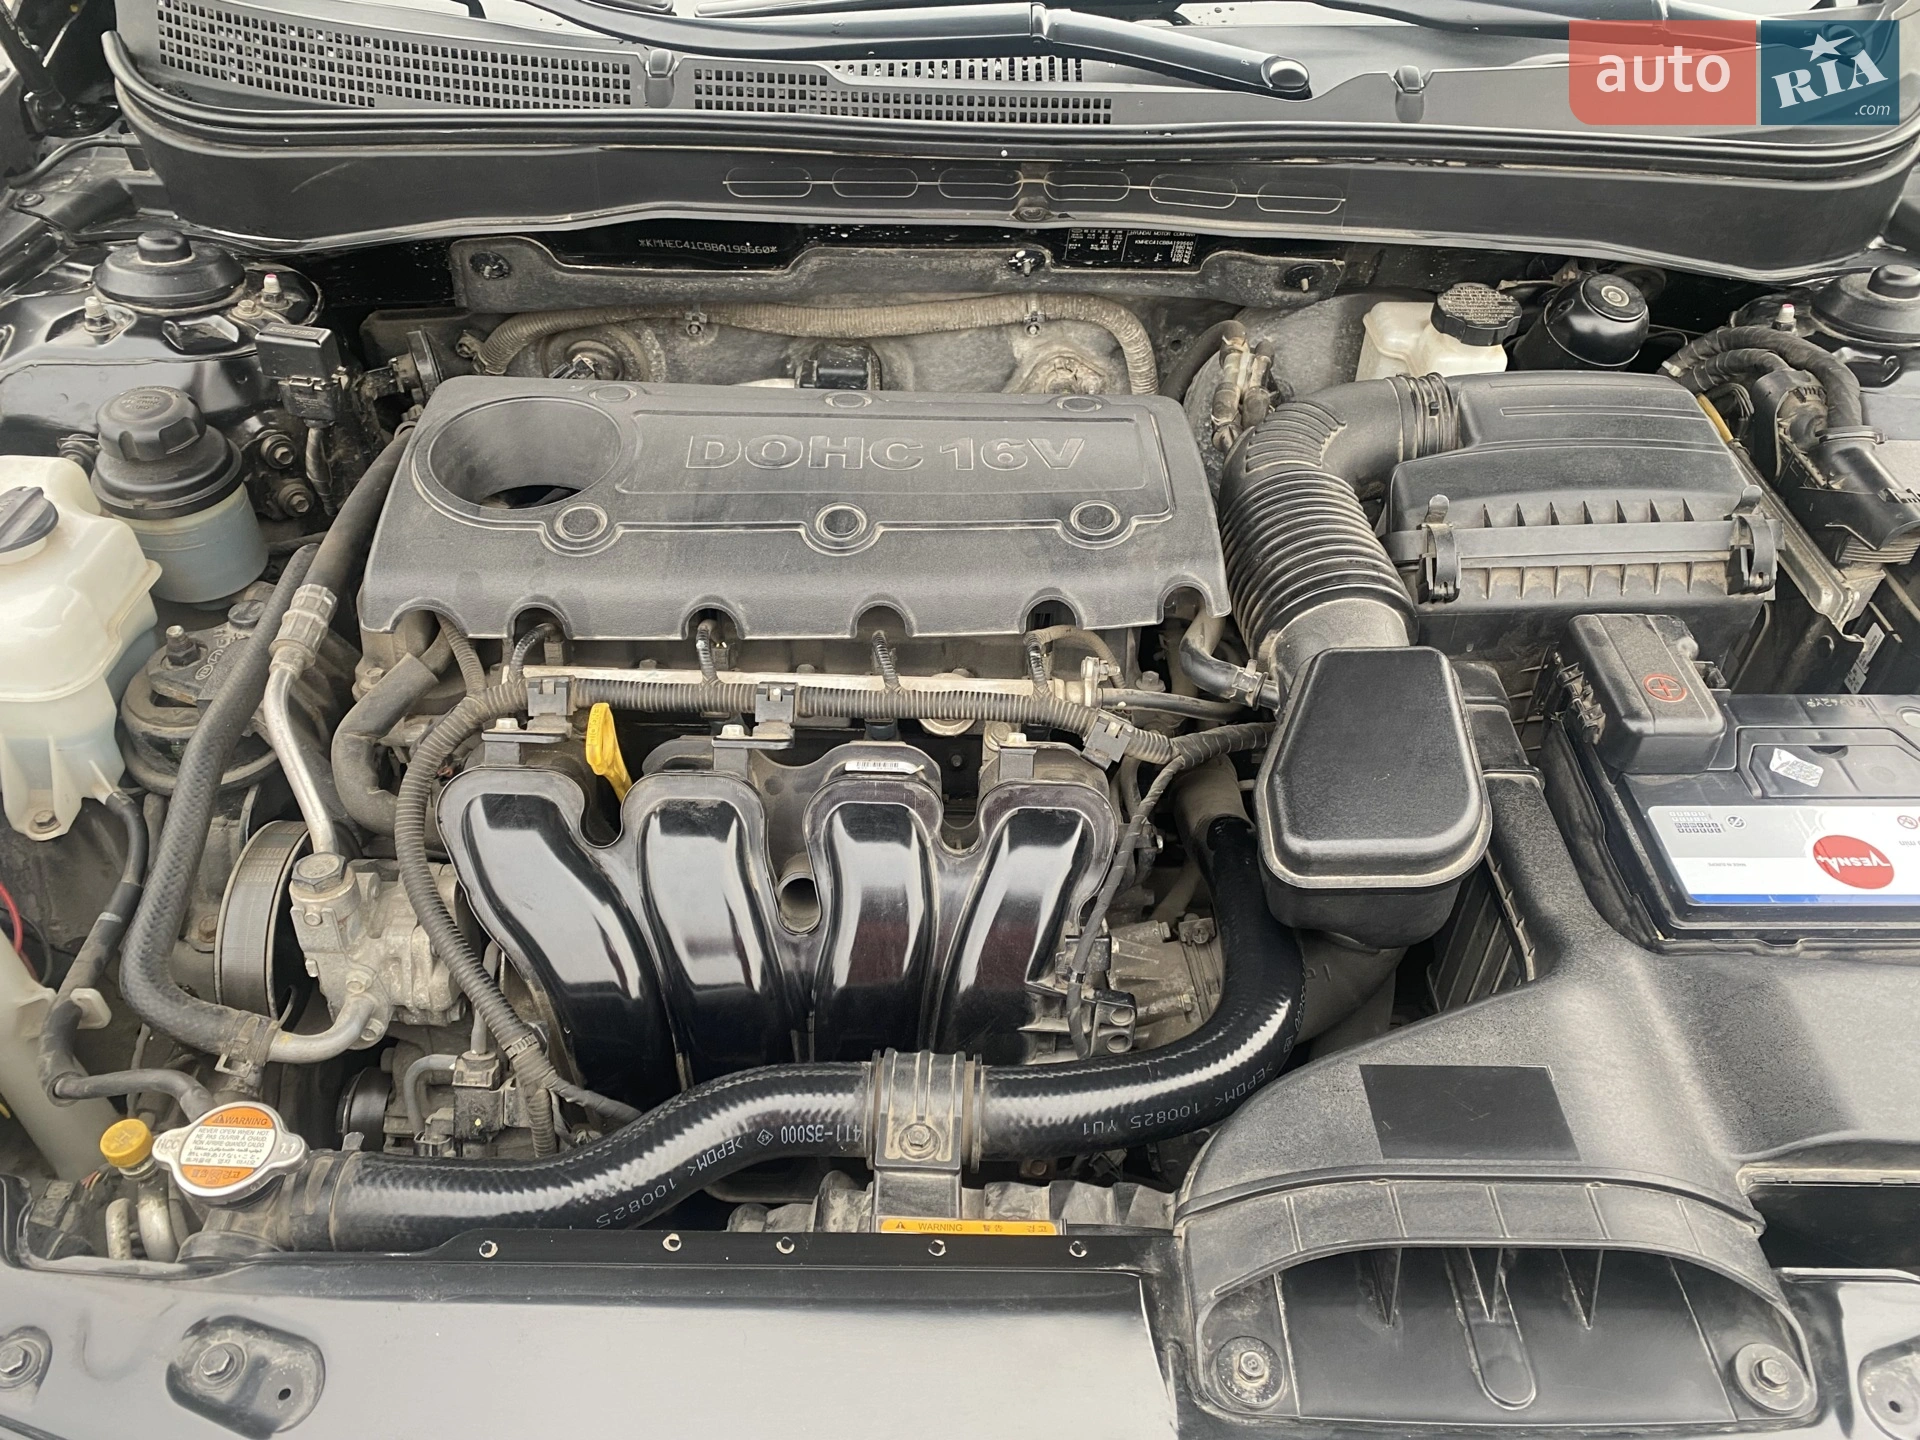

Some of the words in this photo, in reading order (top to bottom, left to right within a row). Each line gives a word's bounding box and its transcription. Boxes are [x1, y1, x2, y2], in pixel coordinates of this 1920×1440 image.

[686, 434, 924, 471] DOHC
[940, 436, 1086, 471] 16V
[225, 1116, 268, 1126] WARNING
[1130, 1102, 1201, 1129] 100825
[1083, 1119, 1117, 1136] YU1
[596, 1177, 677, 1229] 100825
[918, 1222, 963, 1231] WARNING
